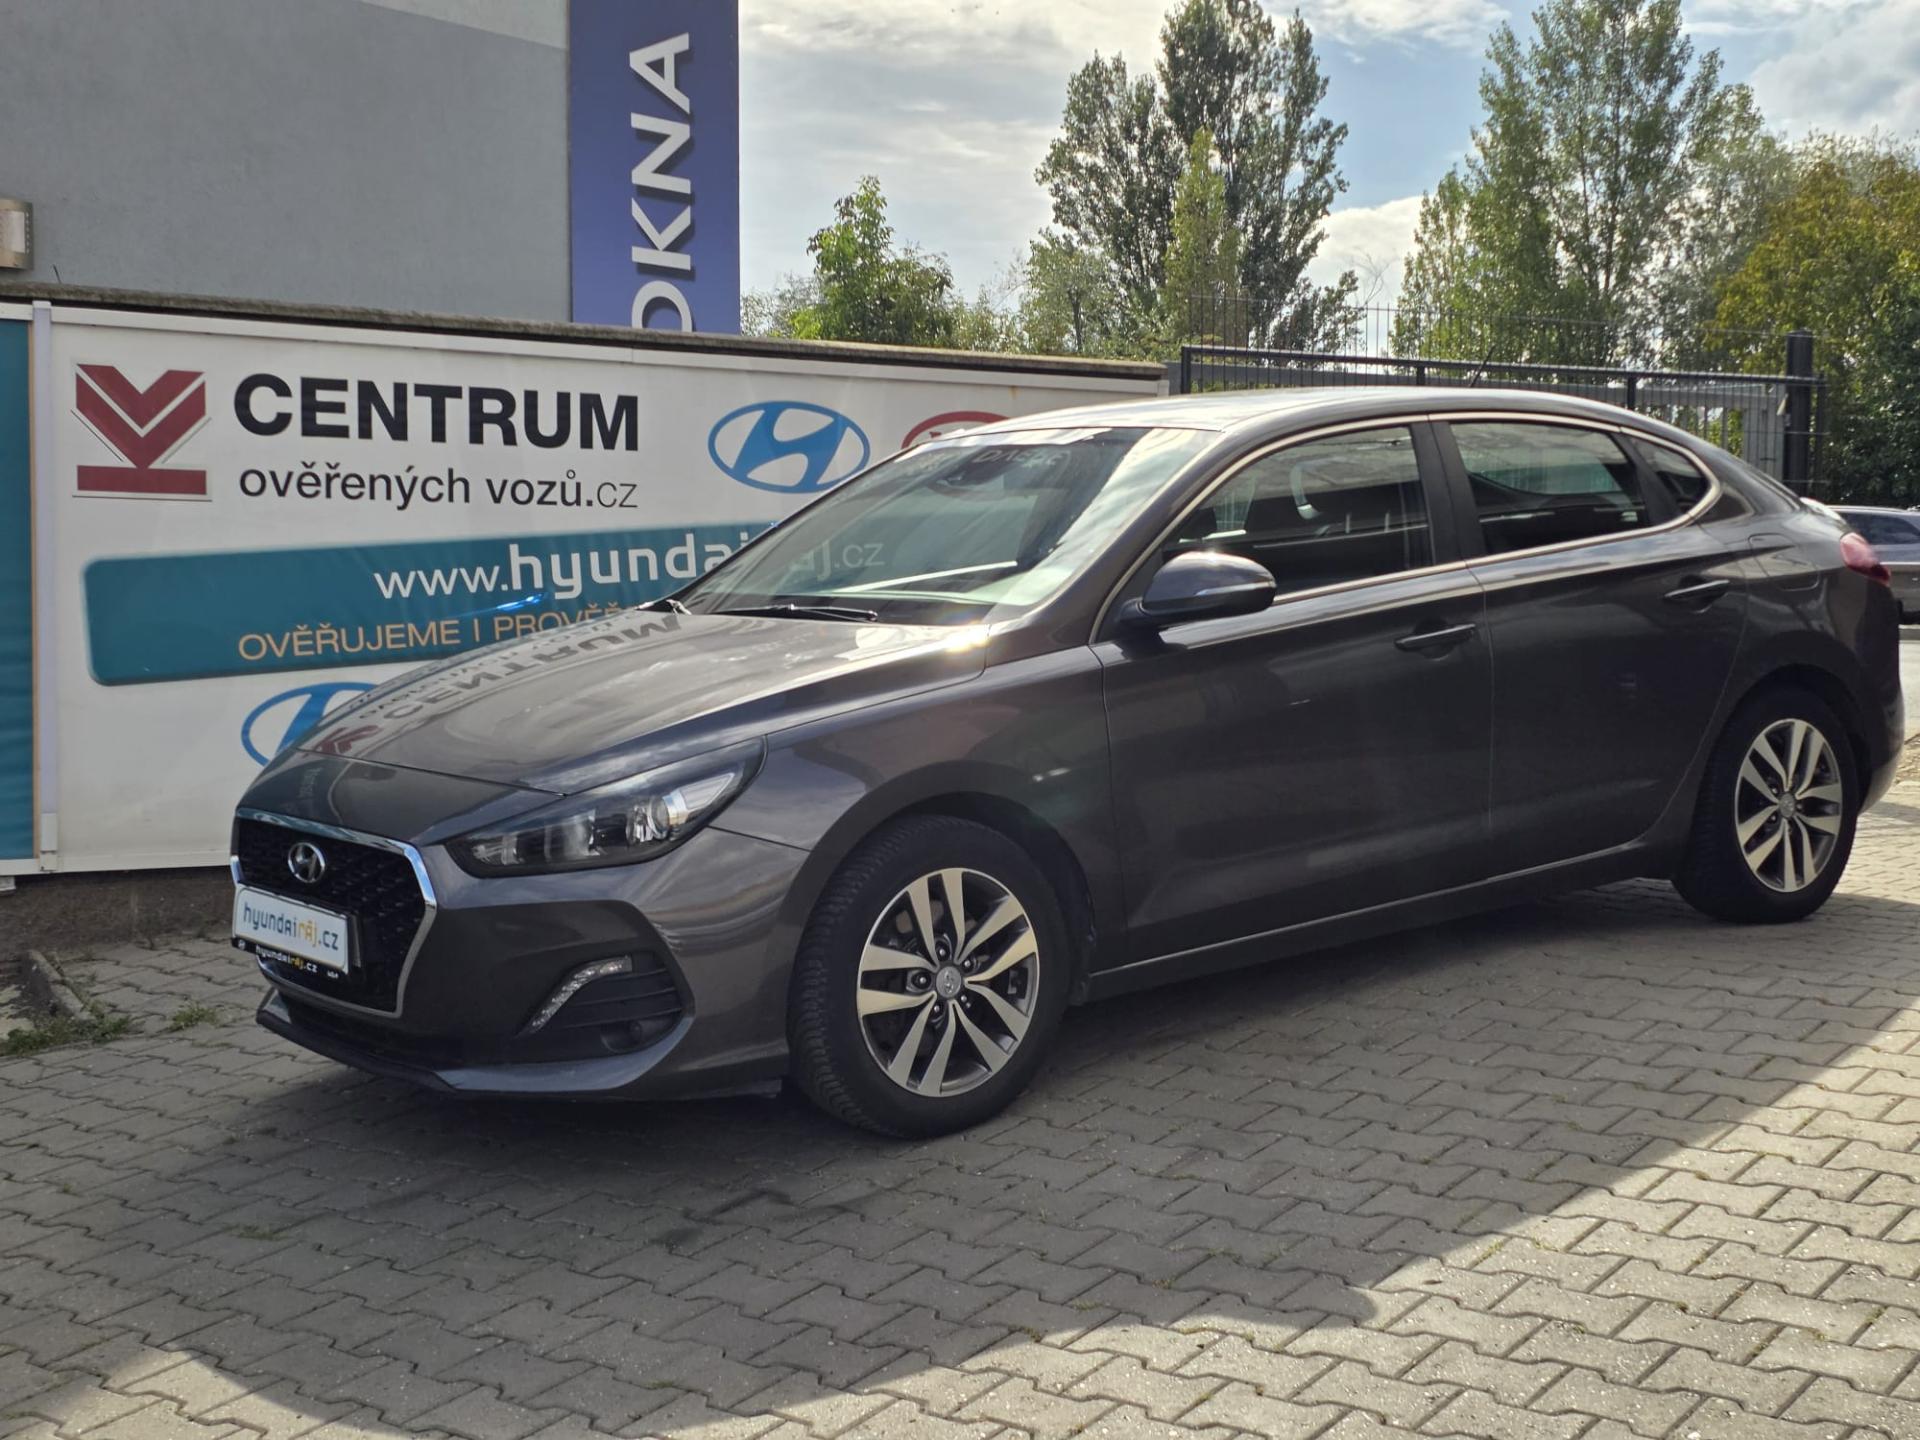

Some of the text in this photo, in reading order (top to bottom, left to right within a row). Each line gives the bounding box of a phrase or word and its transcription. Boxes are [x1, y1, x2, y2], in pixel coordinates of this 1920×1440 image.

[629, 31, 693, 333] OKNA
[233, 373, 639, 452] CENTRUM
[239, 461, 470, 511] ověřených
[238, 620, 461, 661] OVĚŘUJEME
[473, 618, 480, 643] I
